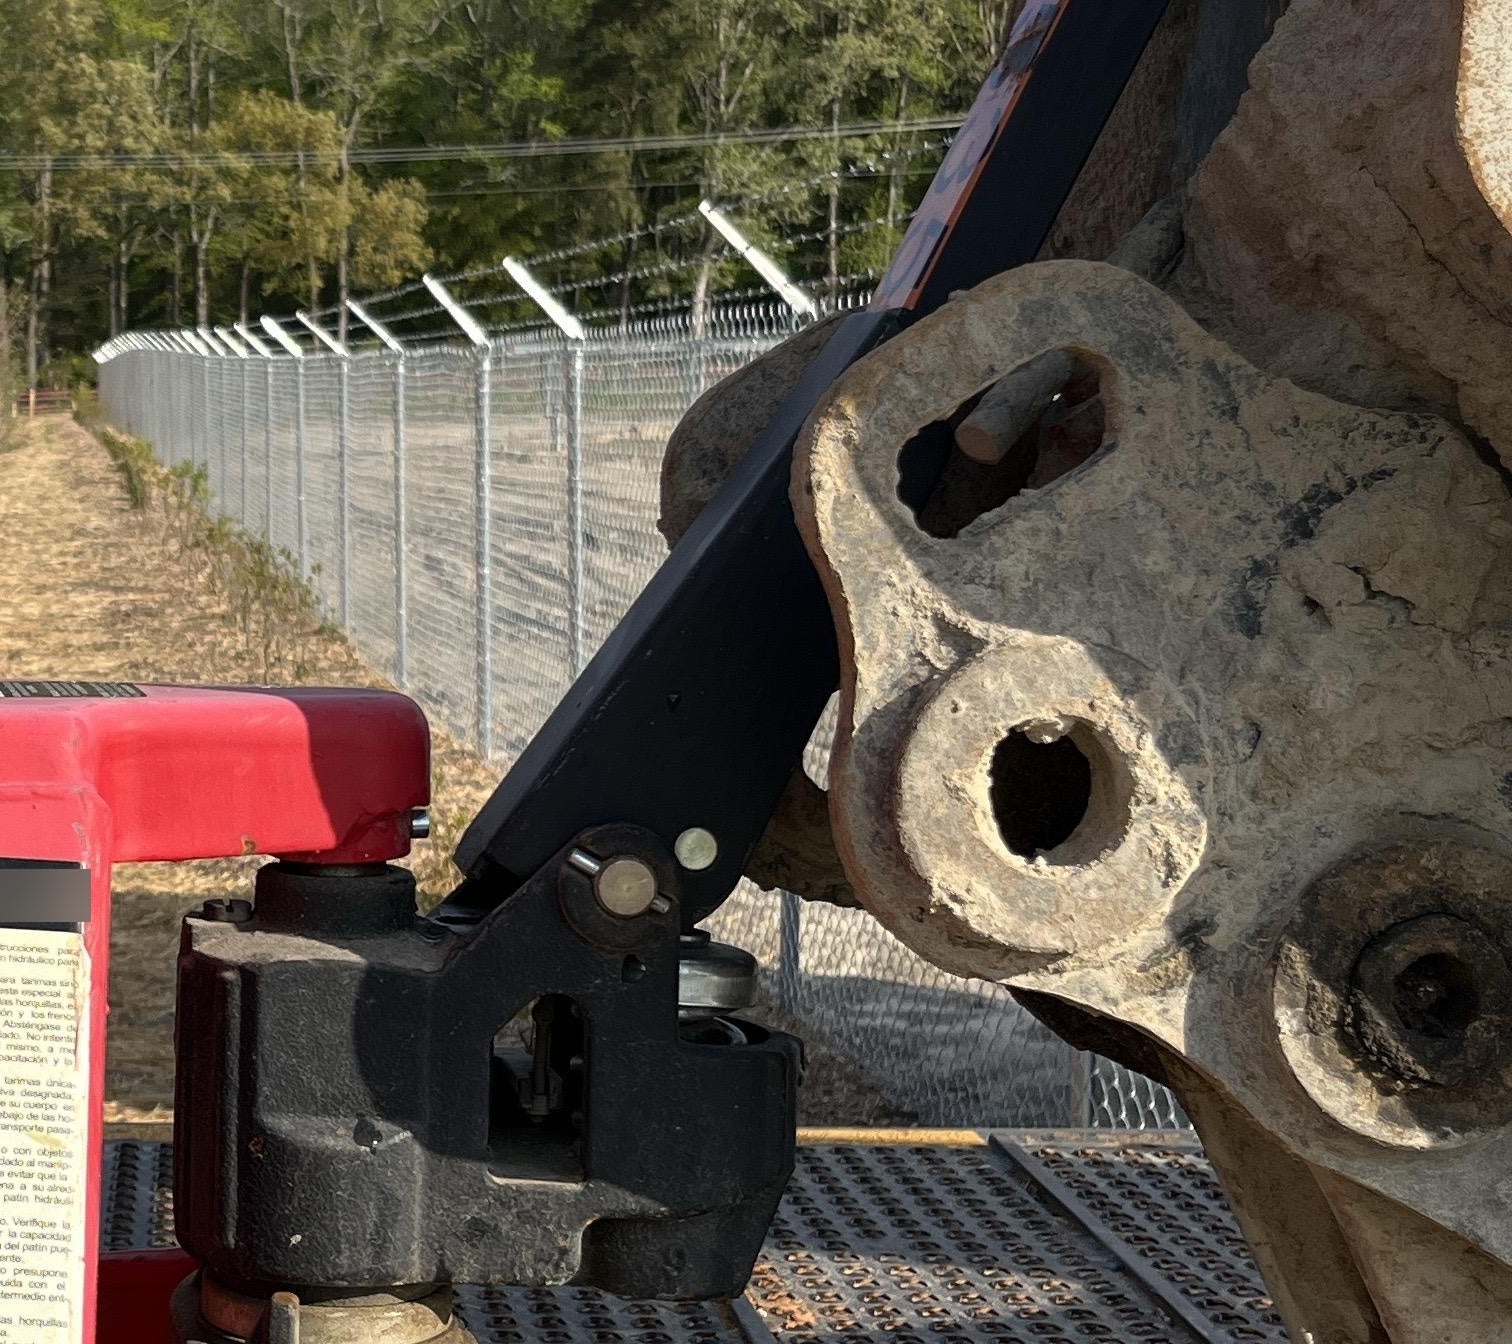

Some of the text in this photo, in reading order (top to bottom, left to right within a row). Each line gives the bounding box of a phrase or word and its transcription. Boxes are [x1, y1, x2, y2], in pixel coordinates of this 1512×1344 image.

[20, 988, 61, 999] especial
[3, 1076, 41, 1085] tarimas
[22, 1102, 58, 1111] cuerpo
[36, 1147, 73, 1159] objetos
[6, 1169, 35, 1178] evitar
[36, 1173, 56, 1182] que
[58, 1172, 68, 1180] la
[7, 1229, 17, 1237] la
[18, 1230, 70, 1243] capacidad
[56, 1281, 66, 1290] el
